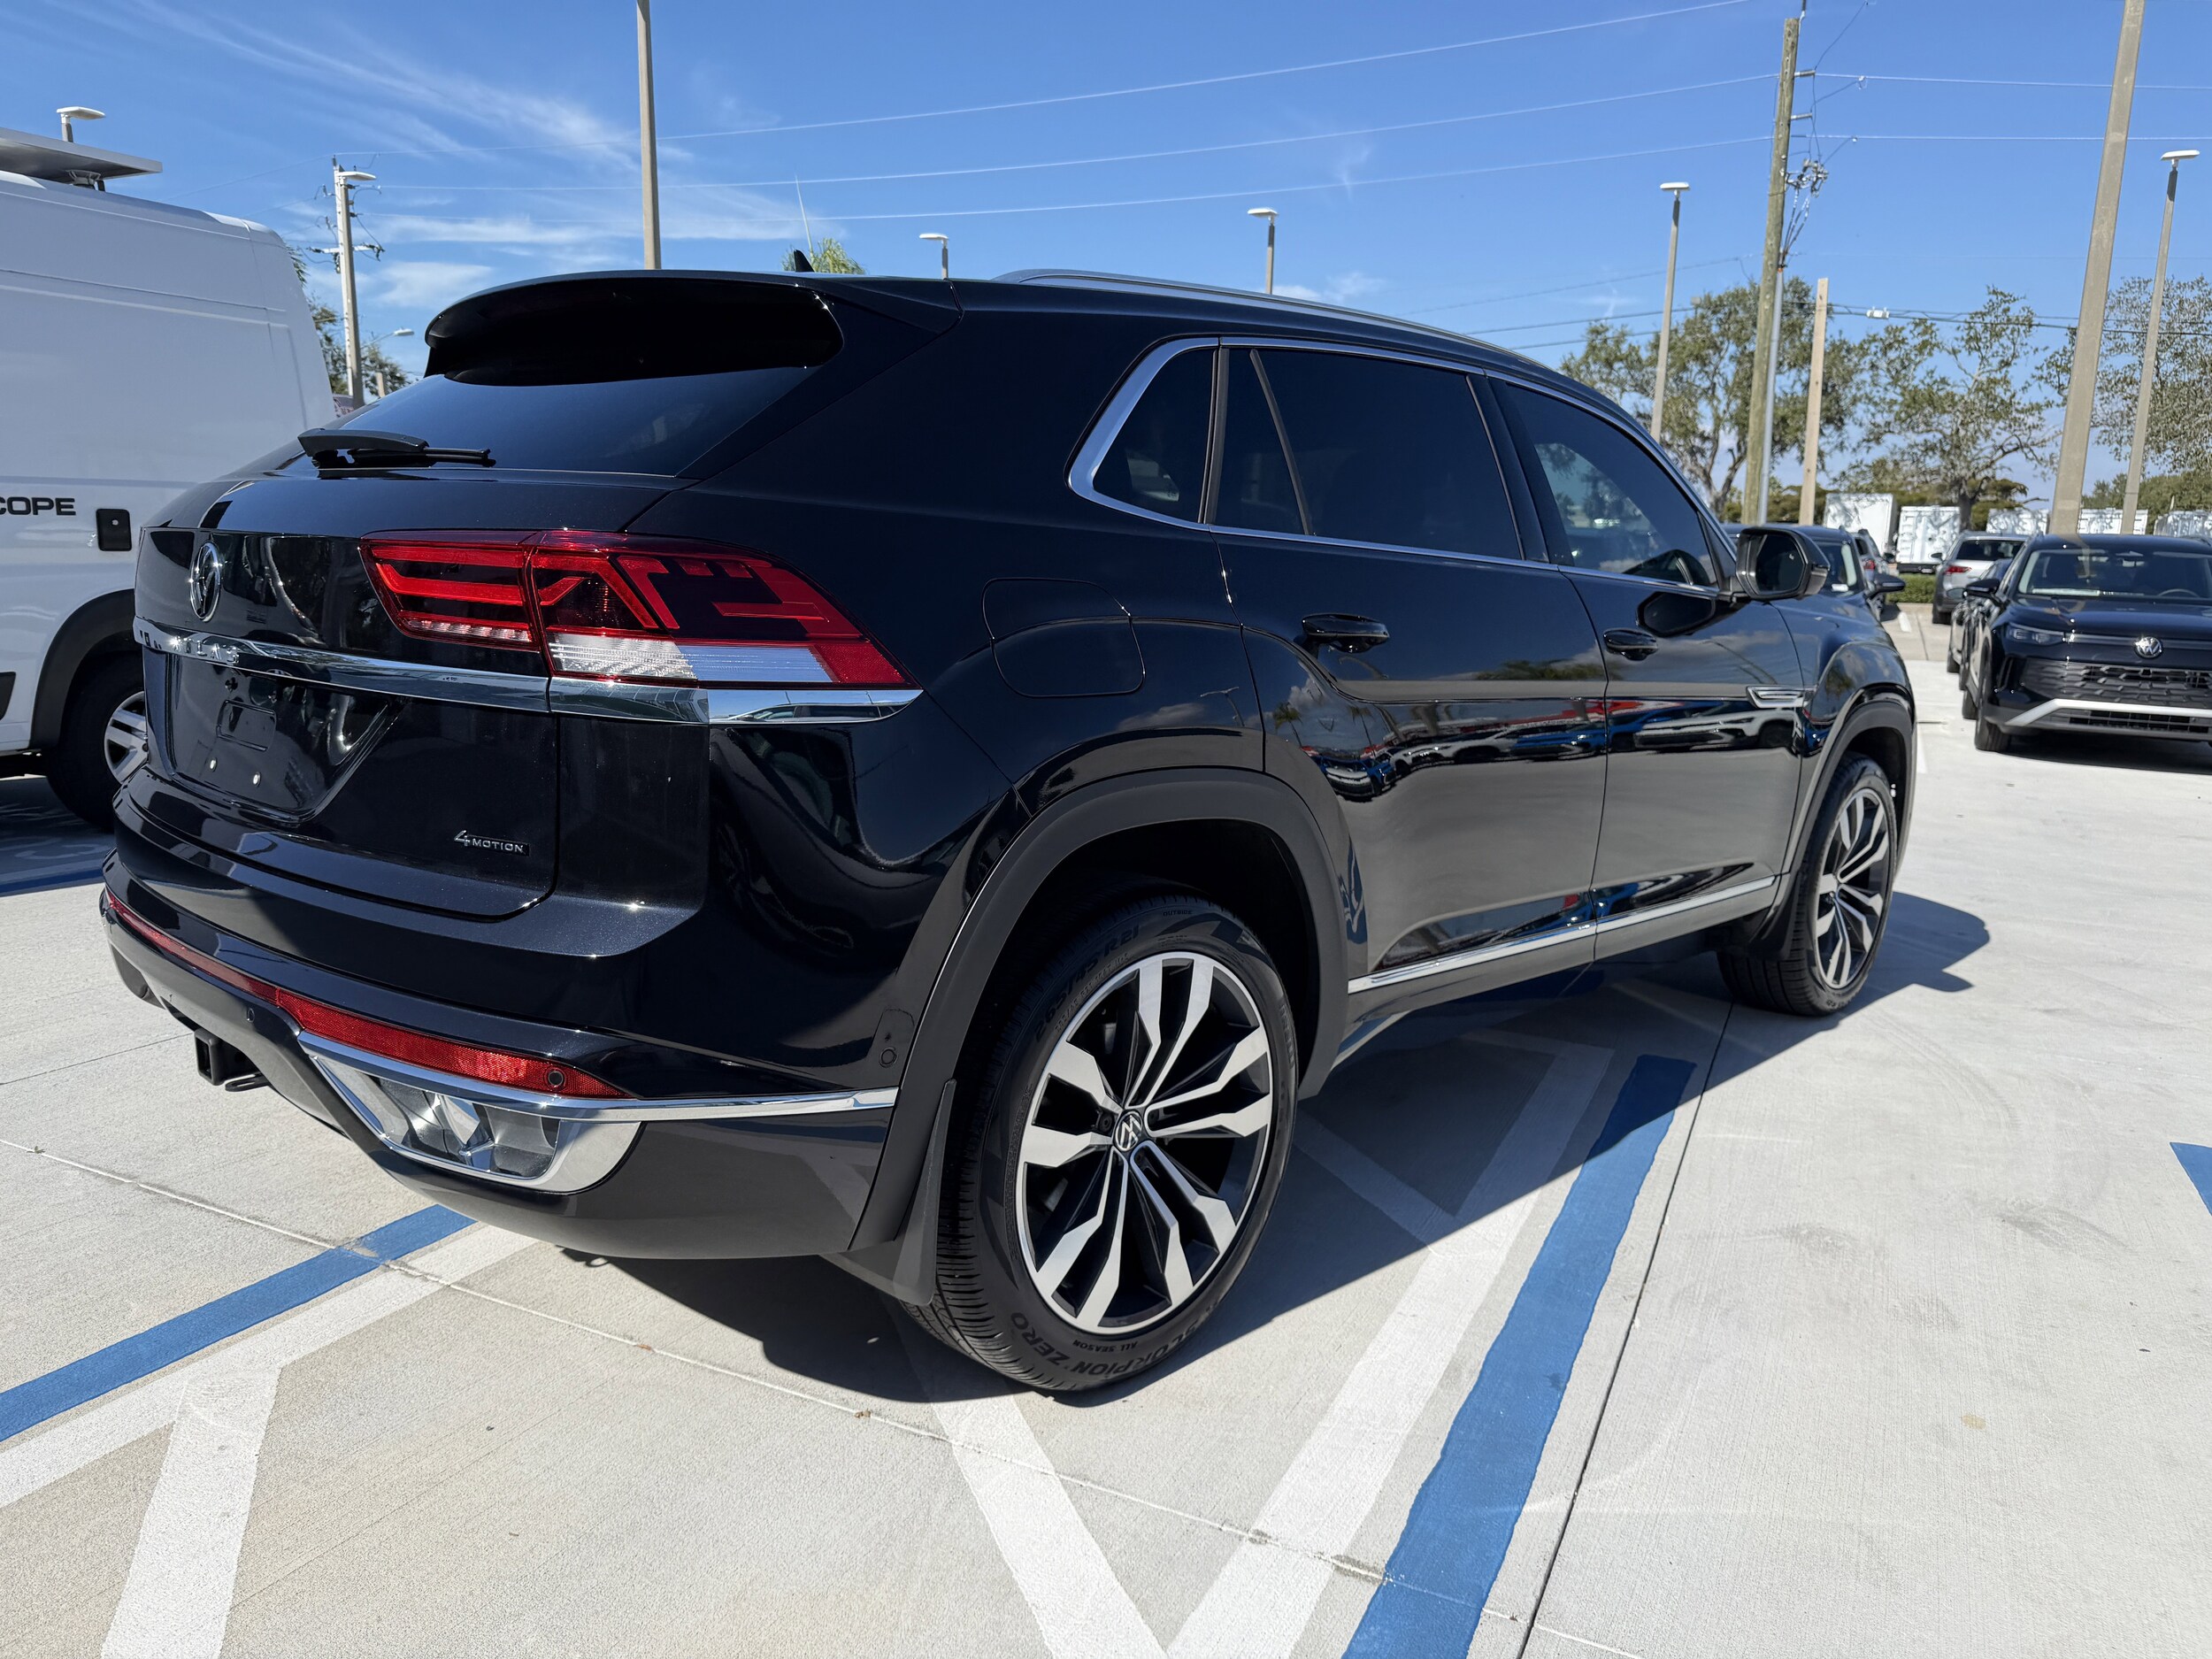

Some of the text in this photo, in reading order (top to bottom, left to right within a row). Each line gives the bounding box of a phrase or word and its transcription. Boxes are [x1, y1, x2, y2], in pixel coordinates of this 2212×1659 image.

[0, 496, 76, 516] OPE
[453, 830, 525, 853] 4MOTION
[1010, 1312, 1071, 1365] ZERO
[1071, 1340, 1139, 1352] ALL SEASON
